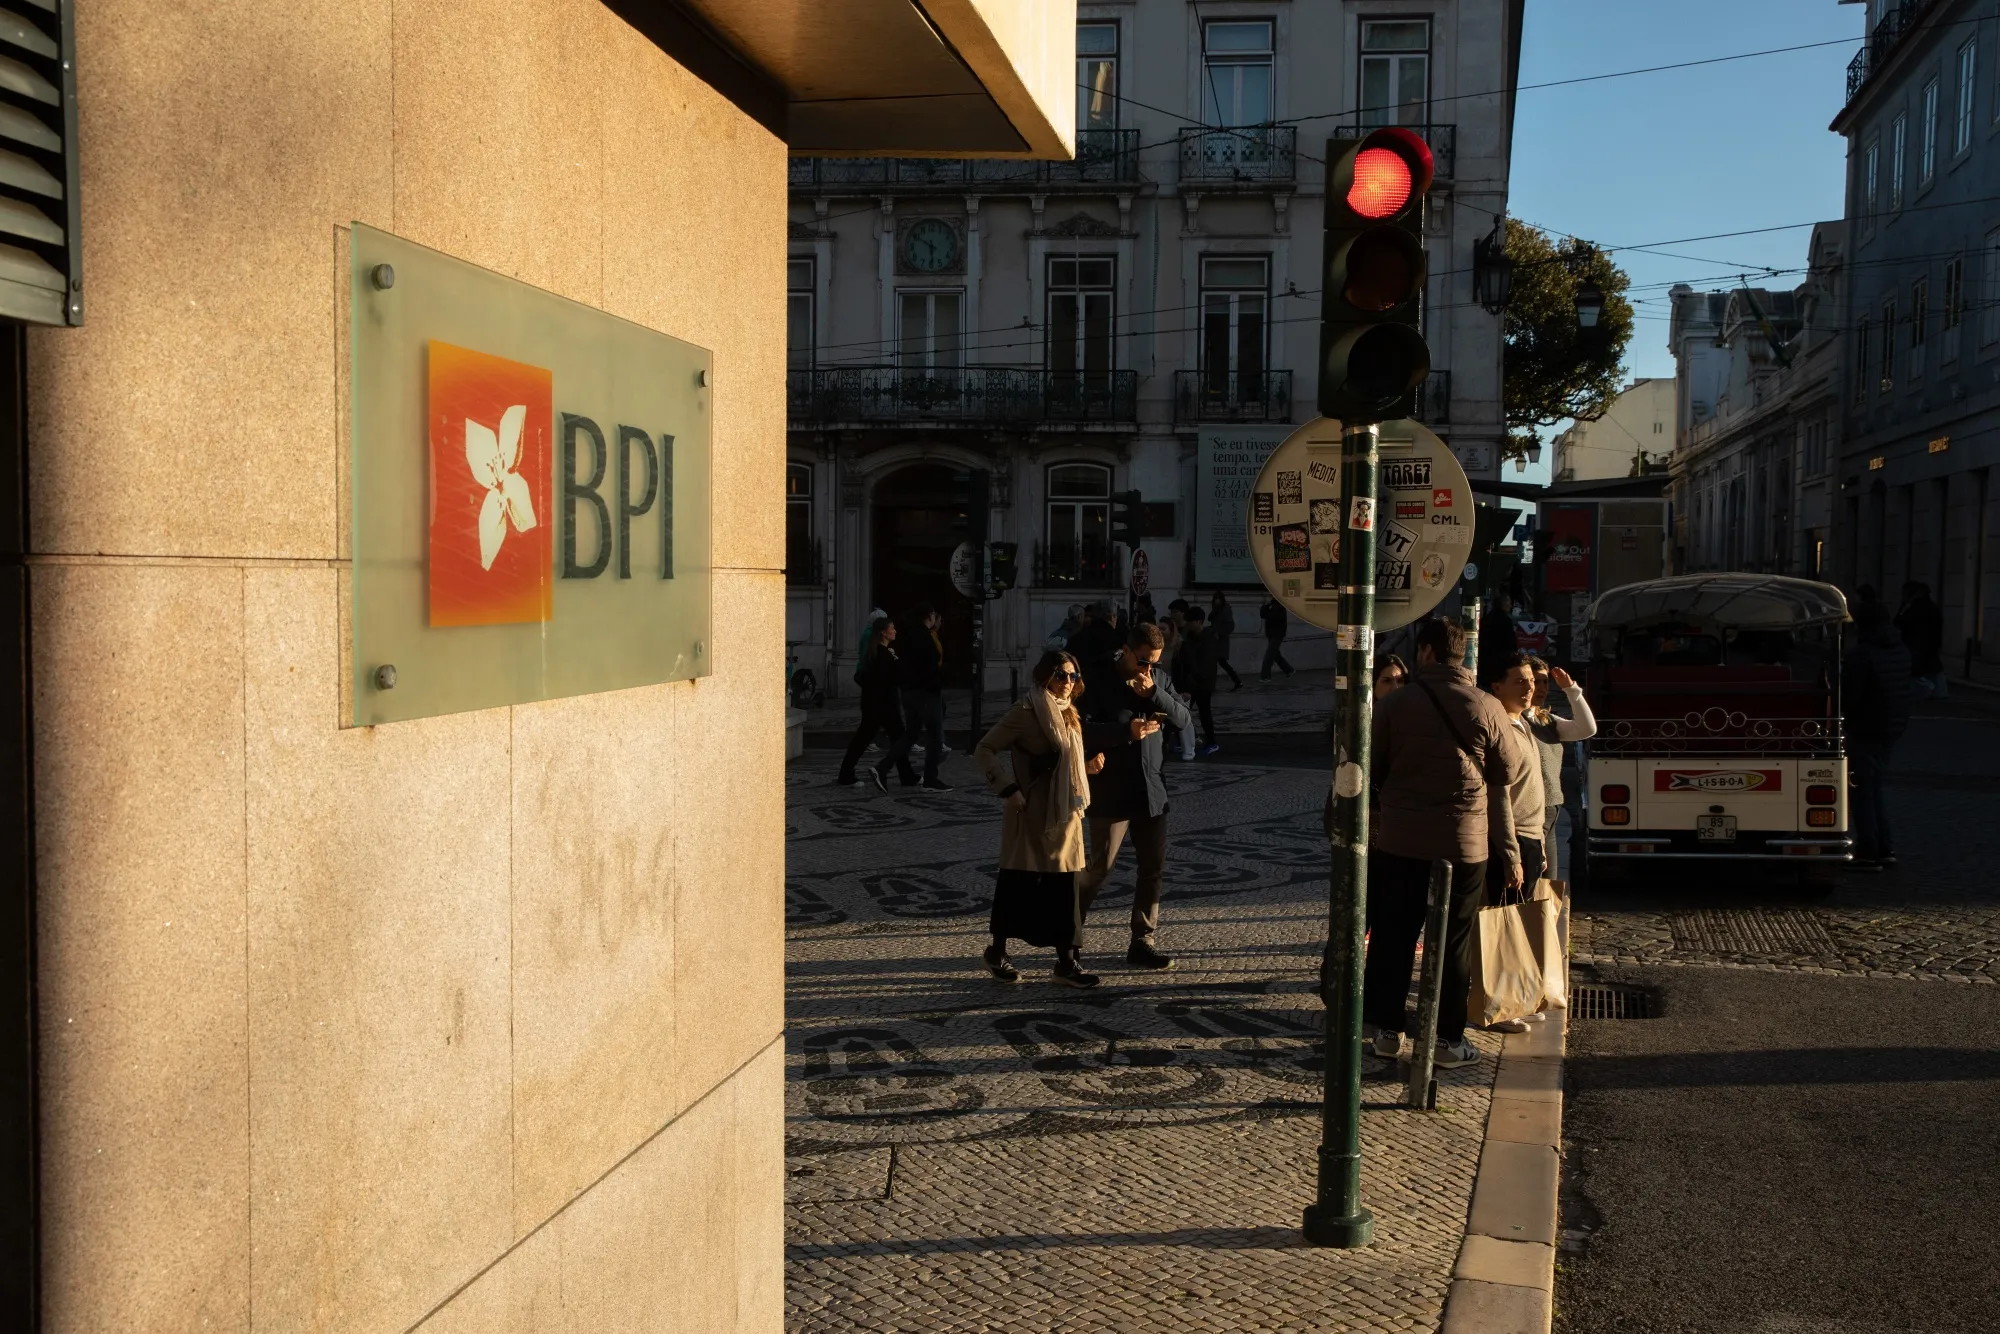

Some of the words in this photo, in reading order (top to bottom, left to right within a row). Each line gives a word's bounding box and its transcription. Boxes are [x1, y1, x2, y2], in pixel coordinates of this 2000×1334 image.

[928, 223, 935, 232] 12
[1230, 440, 1242, 450] eu
[1213, 467, 1237, 475] uma
[1307, 460, 1337, 484] MEDITA
[1215, 480, 1226, 489] 27
[1228, 480, 1250, 489] JAN
[560, 412, 676, 580] BPI
[1215, 490, 1226, 498] 02
[1432, 515, 1460, 525] CML
[1385, 529, 1411, 553] VT
[1570, 546, 1590, 554] Out
[1376, 562, 1410, 575] FOST
[1710, 818, 1724, 828] 89
